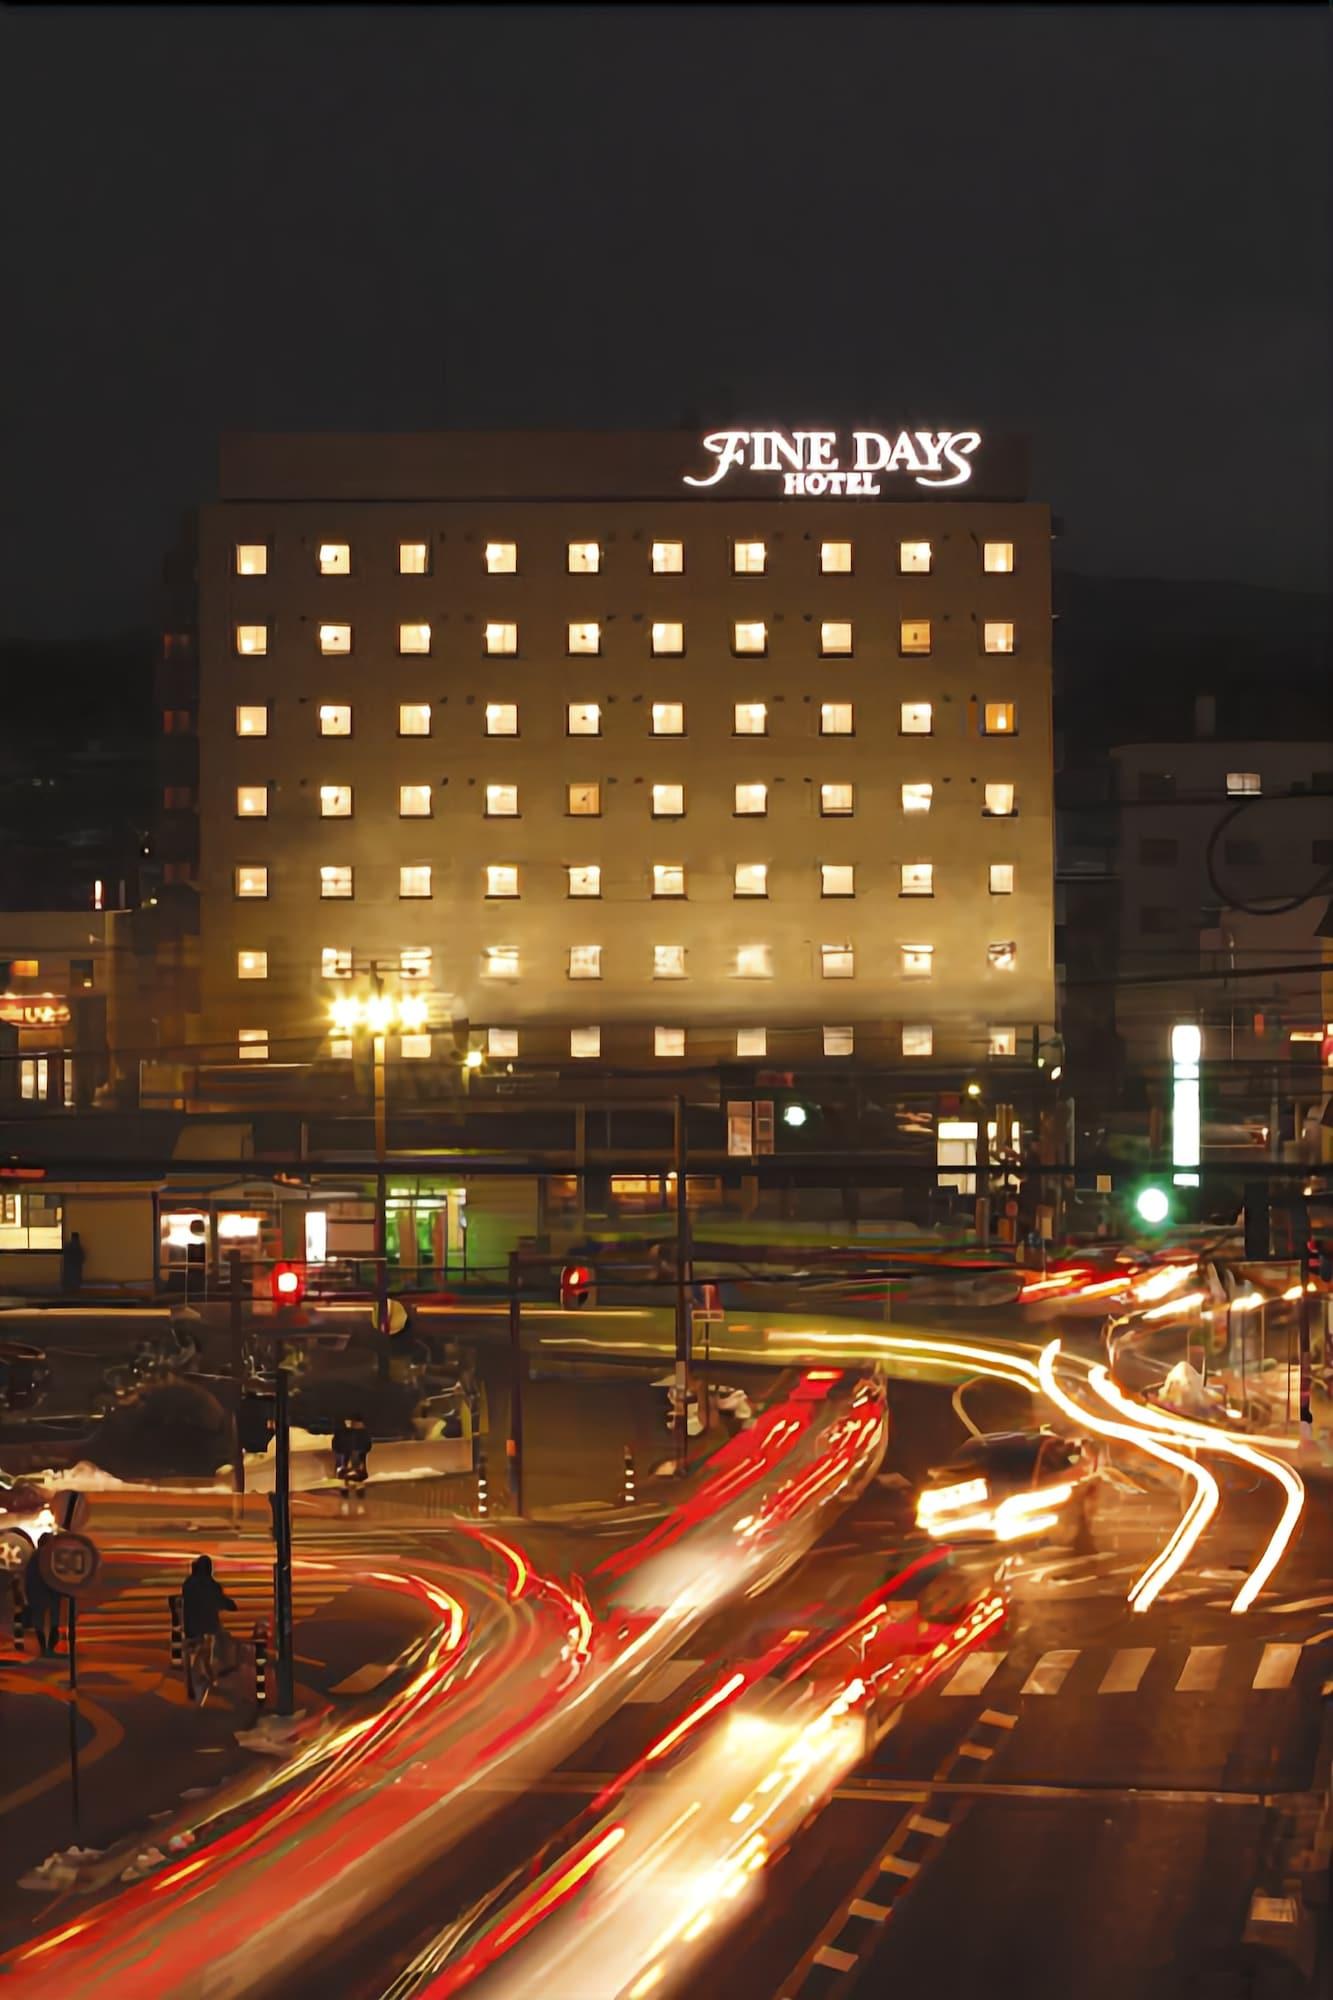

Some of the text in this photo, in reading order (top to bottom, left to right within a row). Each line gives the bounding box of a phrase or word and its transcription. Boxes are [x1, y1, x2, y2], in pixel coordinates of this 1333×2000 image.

[683, 431, 981, 487] FINE DAYS
[783, 472, 881, 495] HOTEL
